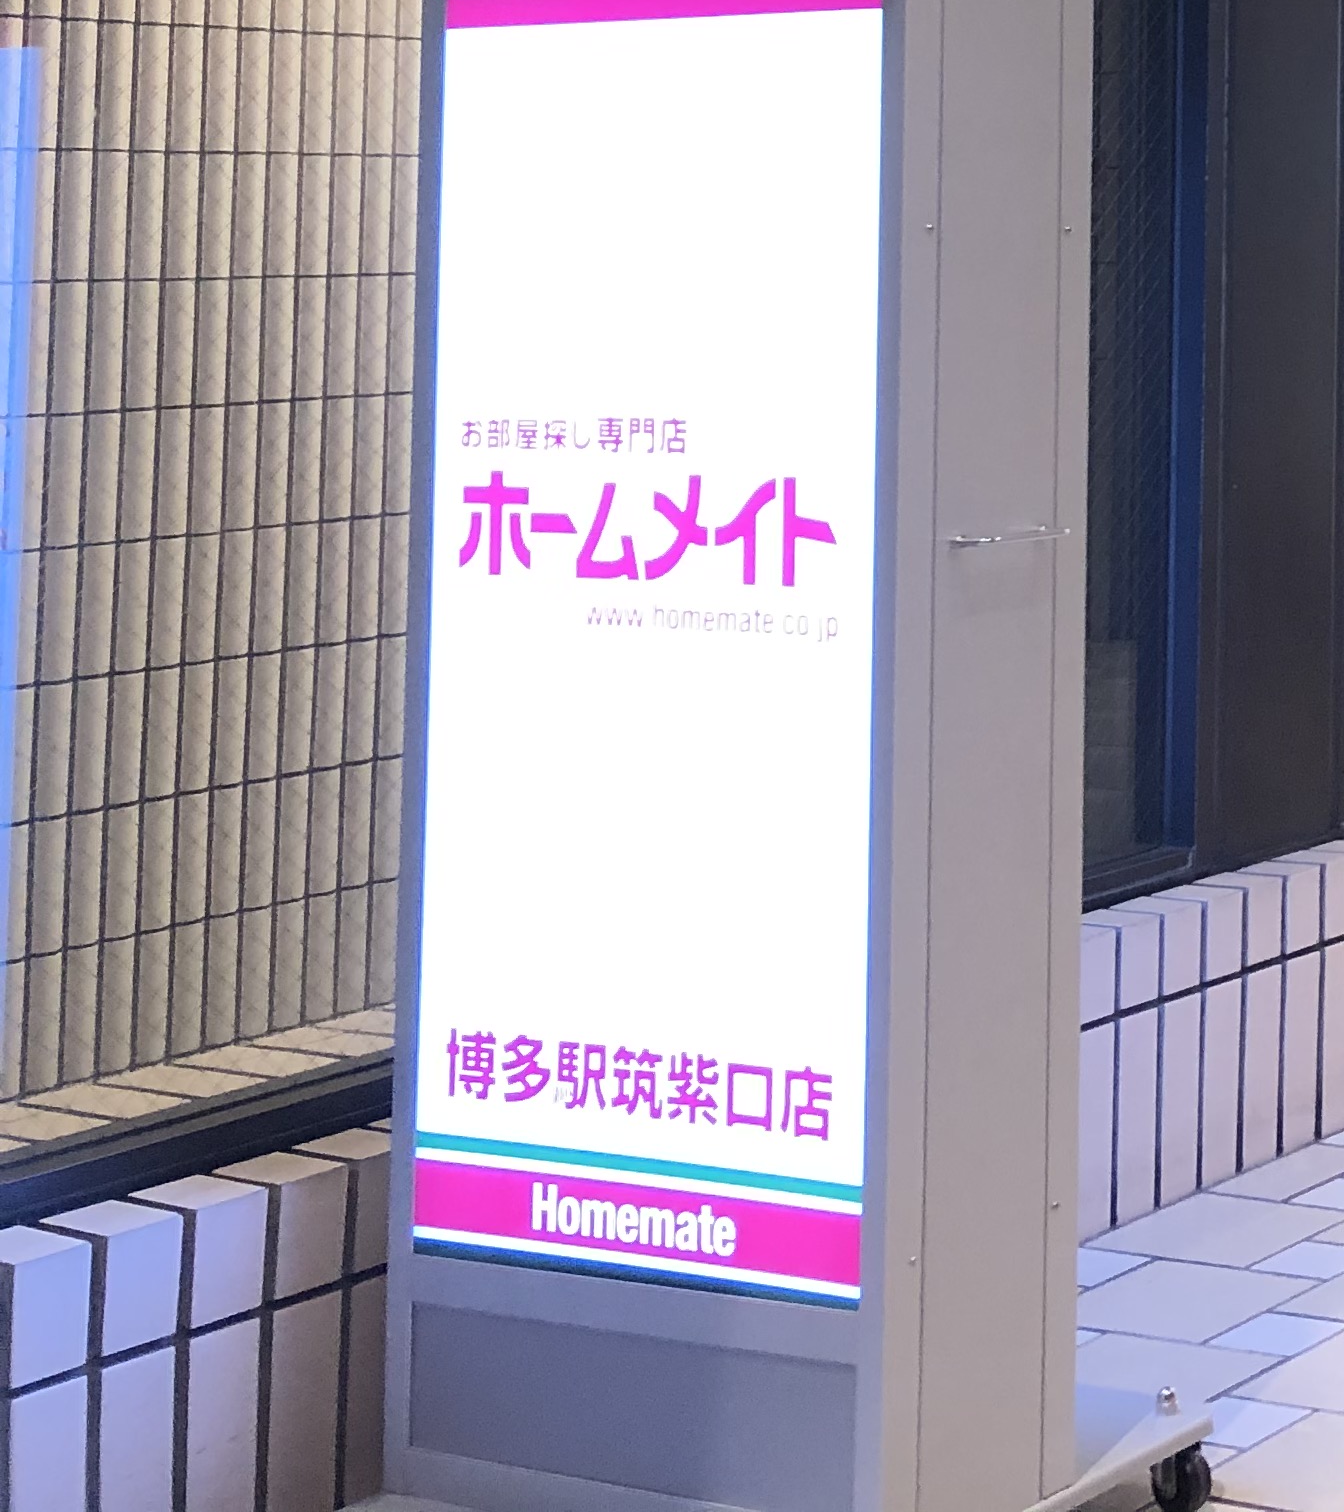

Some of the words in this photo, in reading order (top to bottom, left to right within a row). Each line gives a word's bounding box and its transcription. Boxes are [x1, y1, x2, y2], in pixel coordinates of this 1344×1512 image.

[460, 417, 687, 454] お部屋探し専門店
[459, 470, 837, 587] ホームメイト
[587, 604, 838, 642] wwwhomematecojp
[446, 1028, 833, 1141] 博多駅筑紫口店
[531, 1182, 736, 1258] Homemate
